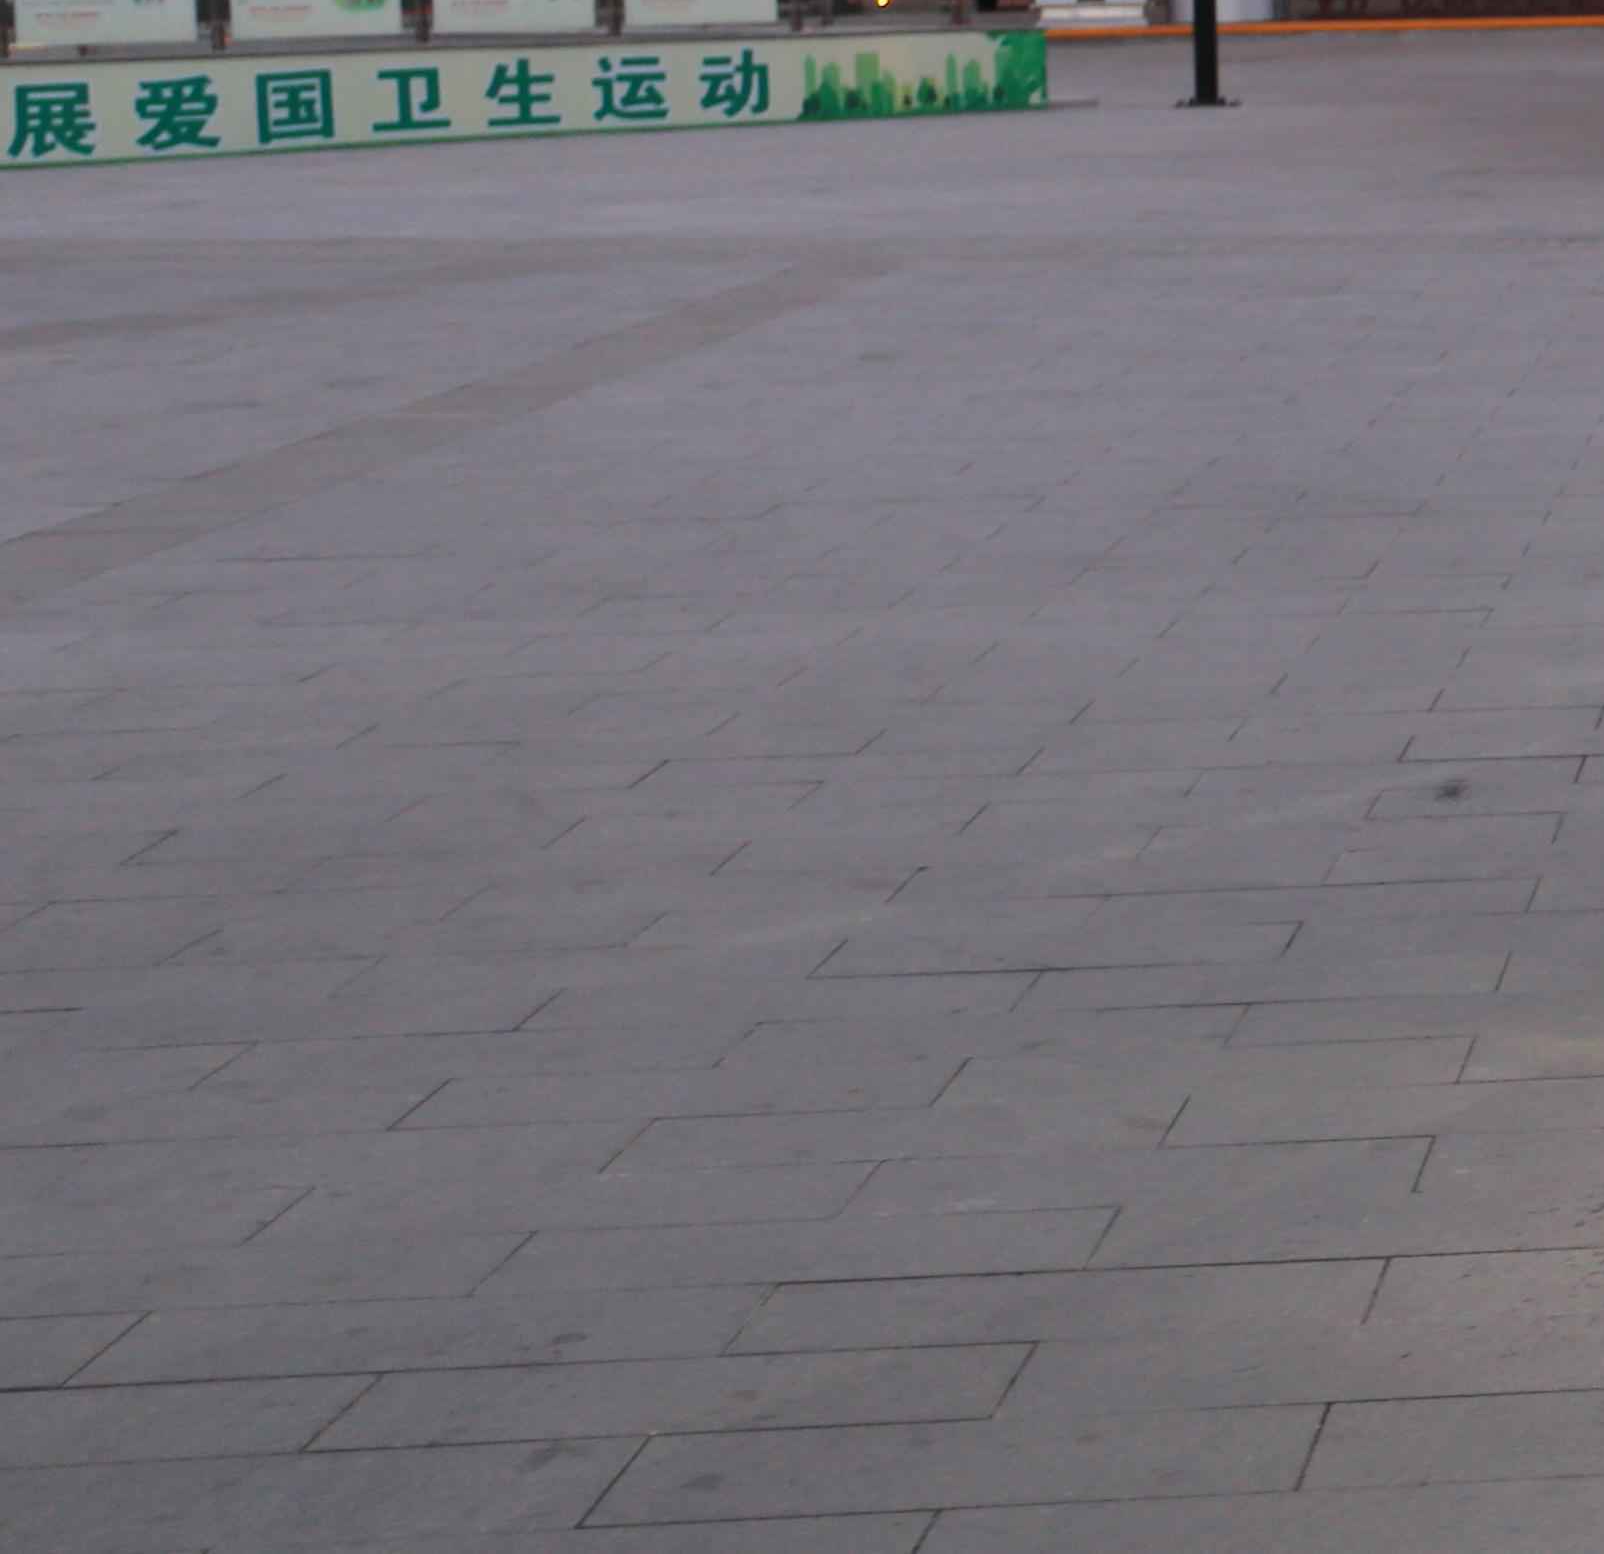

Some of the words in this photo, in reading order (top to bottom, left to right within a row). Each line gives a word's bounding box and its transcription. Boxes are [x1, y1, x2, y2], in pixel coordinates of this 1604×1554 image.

[8, 48, 771, 158] 展爱国卫生运动
